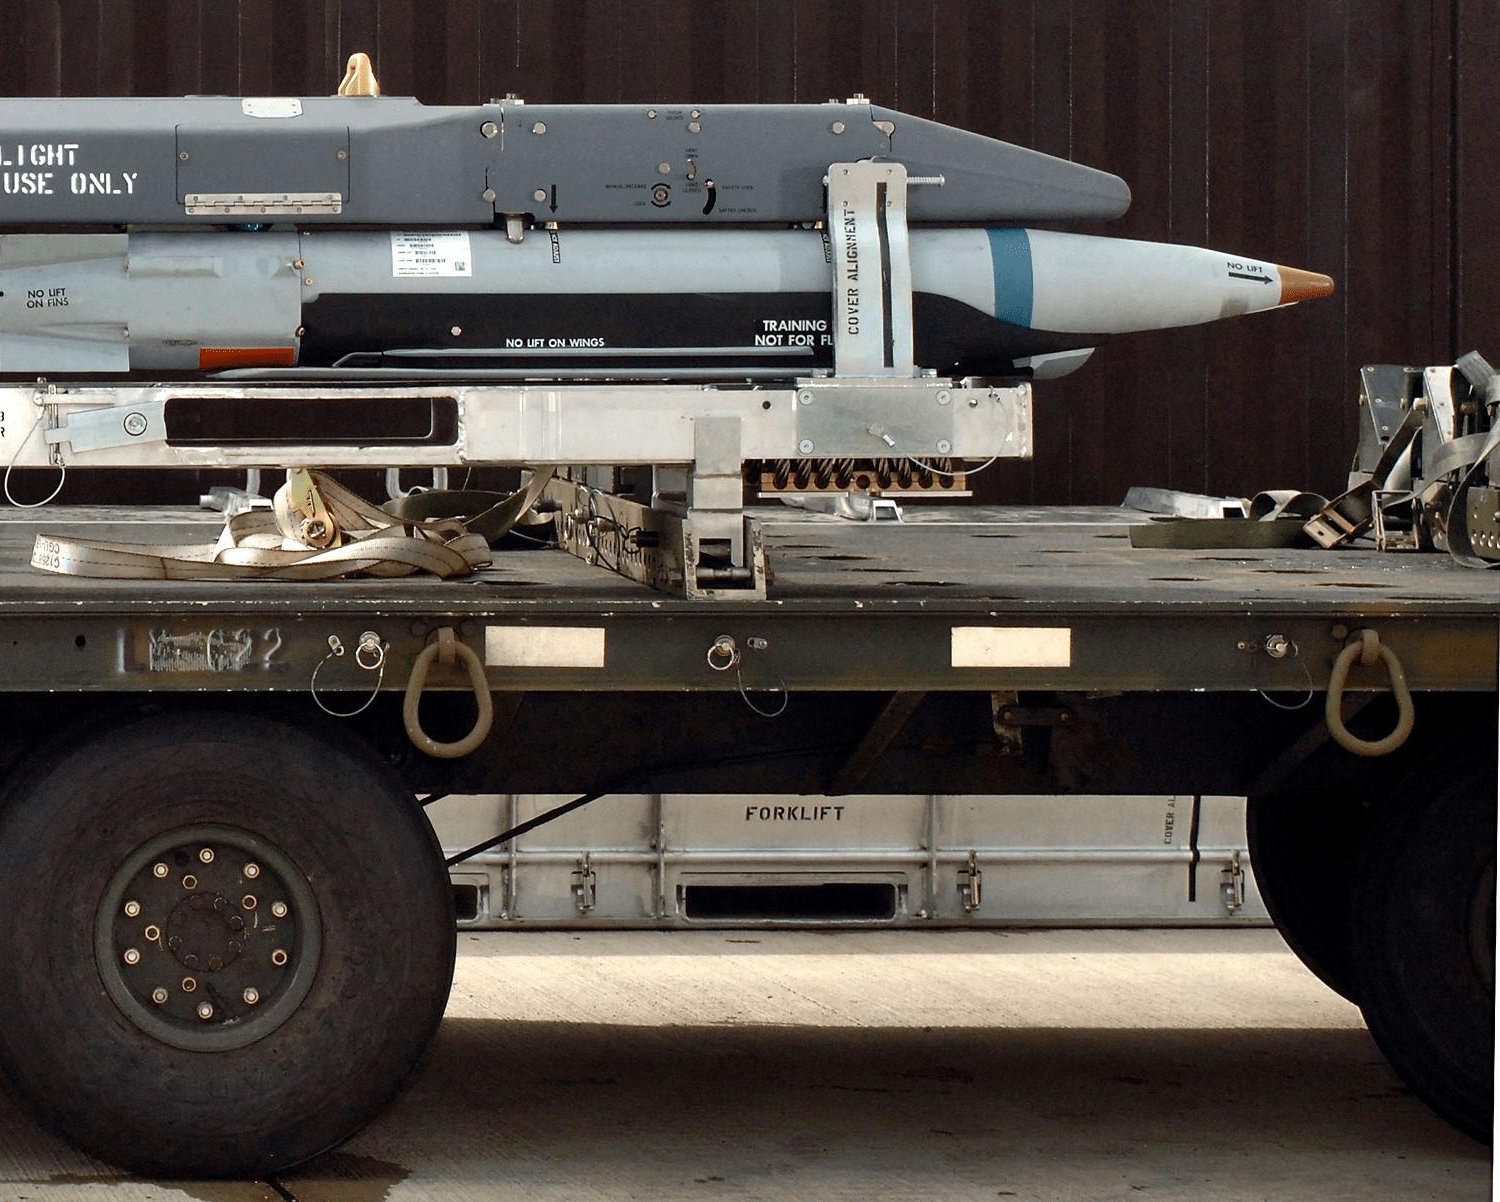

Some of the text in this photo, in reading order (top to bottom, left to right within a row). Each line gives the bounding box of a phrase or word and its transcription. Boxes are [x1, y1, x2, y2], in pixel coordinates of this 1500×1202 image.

[3, 172, 54, 195] USE
[70, 172, 139, 195] ONLY
[844, 209, 859, 335] COVER ALIGNMENT
[1227, 262, 1263, 273] NO LIFT
[27, 287, 66, 298] NO LIFT
[26, 297, 69, 308] ON FINS
[762, 319, 827, 332] TRAINING
[505, 337, 605, 348] NO LIFT ON WINGS
[755, 334, 784, 346] NOT
[788, 334, 815, 346] FOR
[745, 806, 845, 821] FORKLIFT
[1164, 812, 1174, 844] COVER
